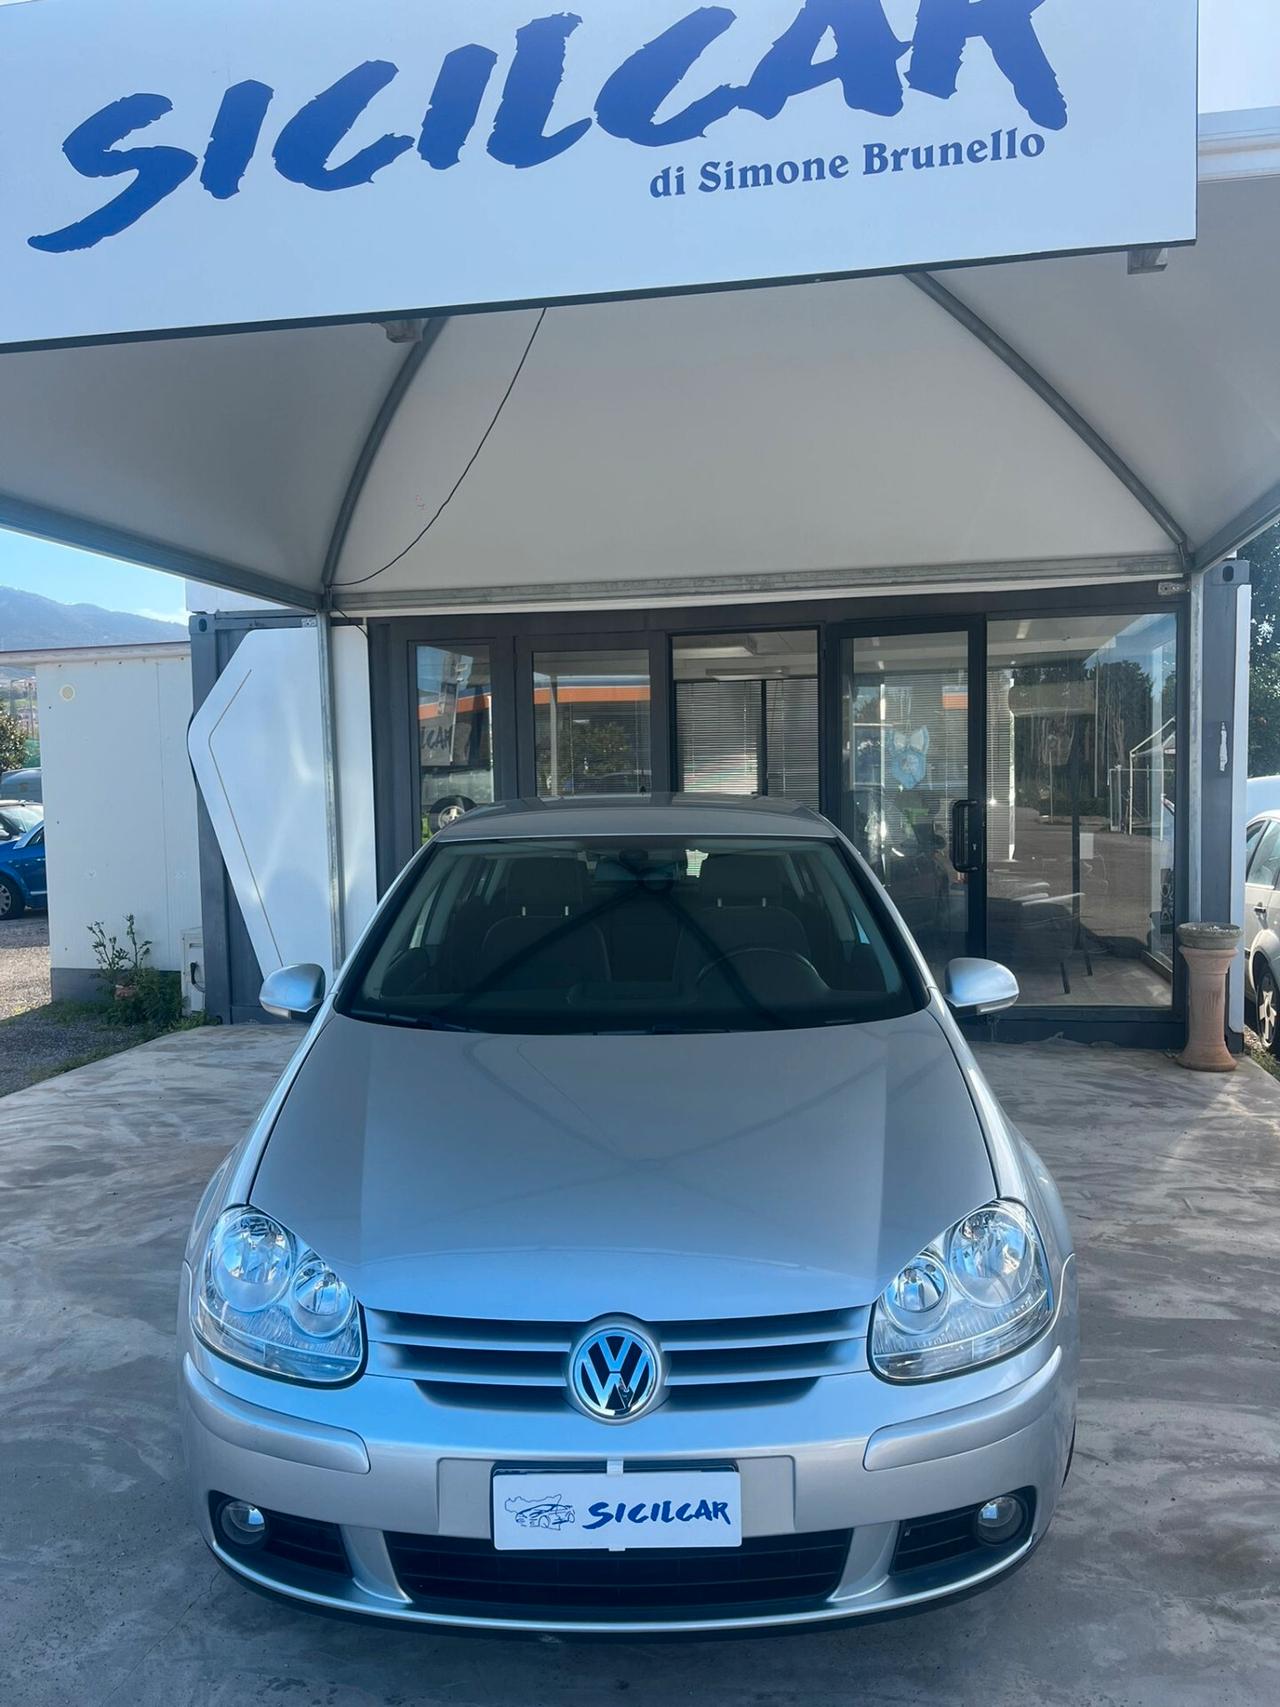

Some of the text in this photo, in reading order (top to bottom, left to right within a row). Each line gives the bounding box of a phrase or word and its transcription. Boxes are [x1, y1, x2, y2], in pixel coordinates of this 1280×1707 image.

[27, 0, 1068, 253] SICILCAR
[649, 127, 1046, 199] di Simone Brunello
[582, 1499, 731, 1530] SICILCAR
